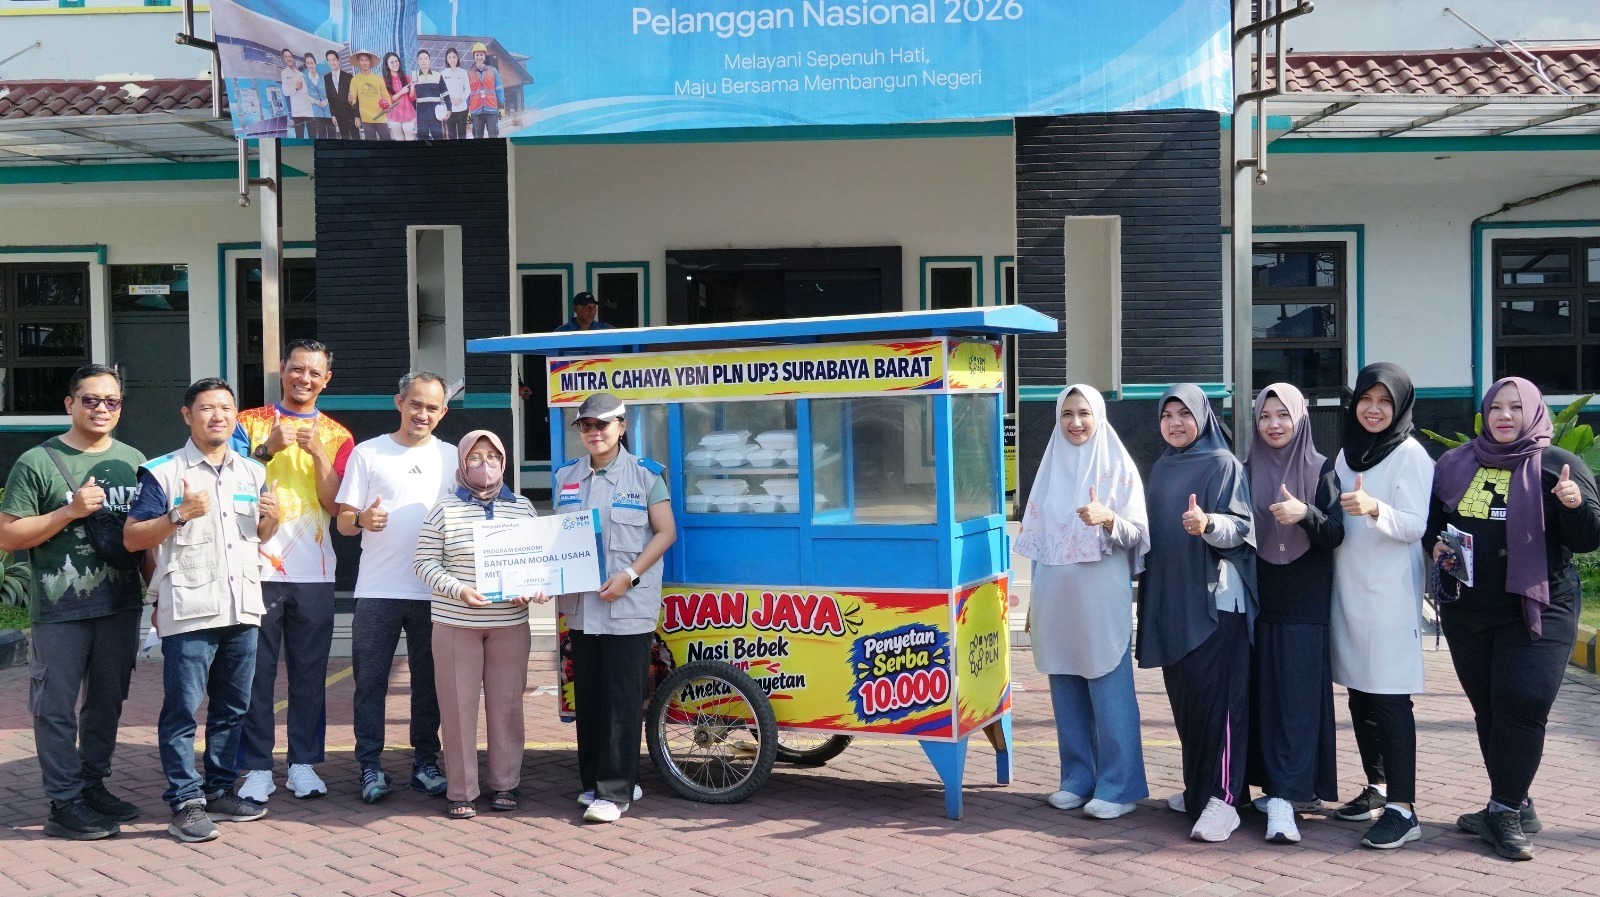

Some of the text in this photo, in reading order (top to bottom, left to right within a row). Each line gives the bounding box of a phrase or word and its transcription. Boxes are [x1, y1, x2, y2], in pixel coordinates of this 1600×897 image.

[632, 0, 1023, 38] Pelanggan Nasional 2026
[724, 47, 930, 72] Melayani Sepenuh Hati,
[674, 69, 982, 99] Maju Bersama Membangun Negeri
[561, 356, 933, 392] MITRA CAHAYA YBM PLN UP3 SURABAYA BARAT
[484, 550, 590, 568] BANTUAN MODAL USAHA
[515, 545, 543, 553] EKONOMI
[484, 571, 501, 579] MIT
[662, 591, 845, 636] IVAN JAYA
[687, 636, 789, 663] Nasi Bebek
[863, 629, 935, 659] Penyetan
[984, 630, 999, 649] YBM
[873, 648, 929, 676] Serba
[985, 647, 999, 666] PLN
[859, 668, 949, 715] 10.000
